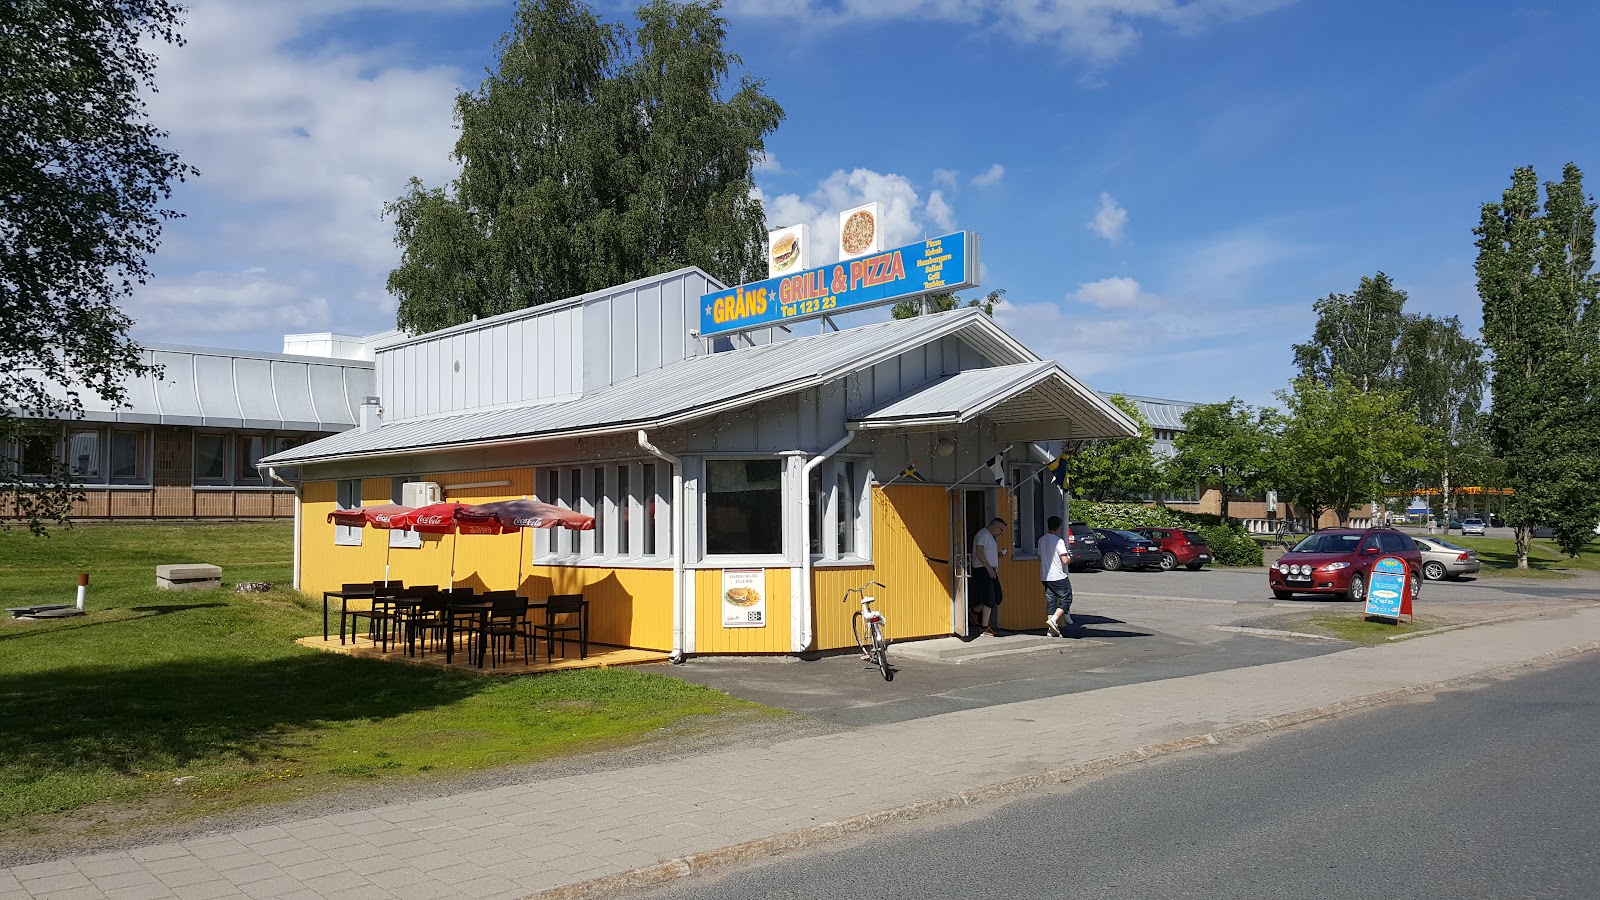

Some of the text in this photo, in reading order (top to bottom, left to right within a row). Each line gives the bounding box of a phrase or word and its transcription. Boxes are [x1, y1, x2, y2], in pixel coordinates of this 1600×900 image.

[925, 246, 943, 257] Kebab
[779, 251, 906, 305] GRILL & PIZZA
[713, 287, 768, 324] GRÄNS
[781, 296, 837, 317] Tel 123 23
